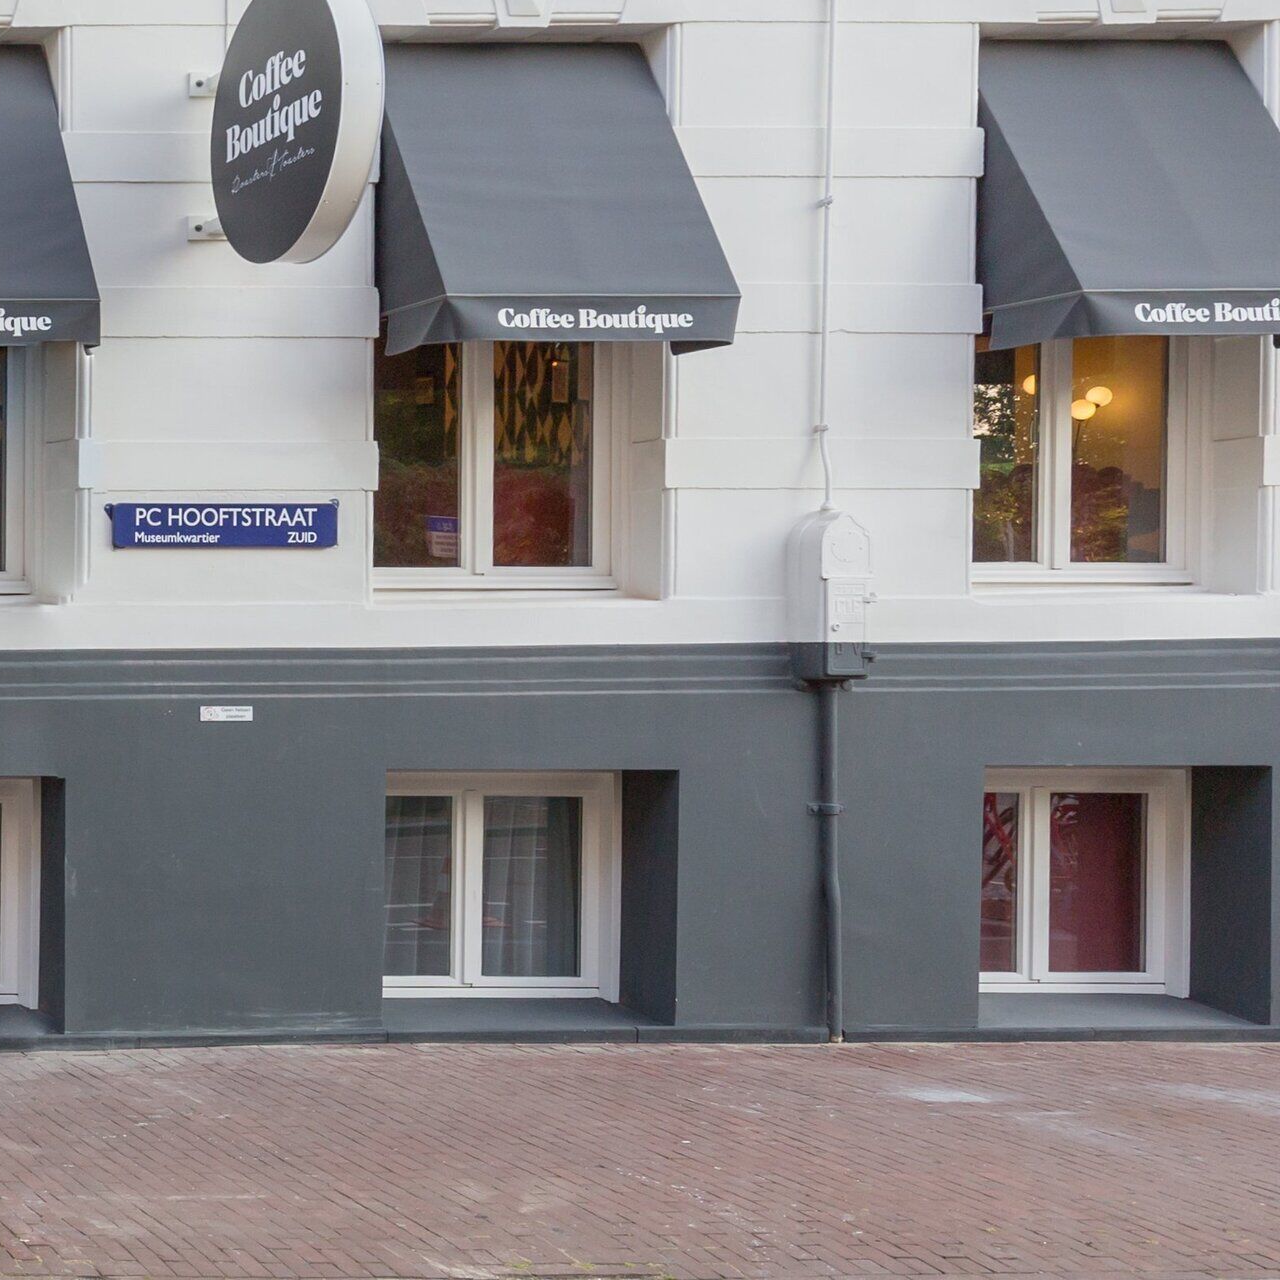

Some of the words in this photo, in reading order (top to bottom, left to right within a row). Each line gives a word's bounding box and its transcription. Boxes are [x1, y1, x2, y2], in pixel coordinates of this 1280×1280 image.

[238, 48, 307, 109] Coffee
[225, 88, 324, 164] Boutique
[497, 307, 575, 329] Coffee
[578, 304, 694, 333] Boutique
[1134, 302, 1210, 323] Coffee
[1214, 297, 1280, 322] Bouti
[134, 507, 162, 527] PC
[168, 507, 318, 527] HOOFTSTRAAT
[134, 532, 220, 544] Museumkwartier
[287, 532, 318, 544] ZUID
